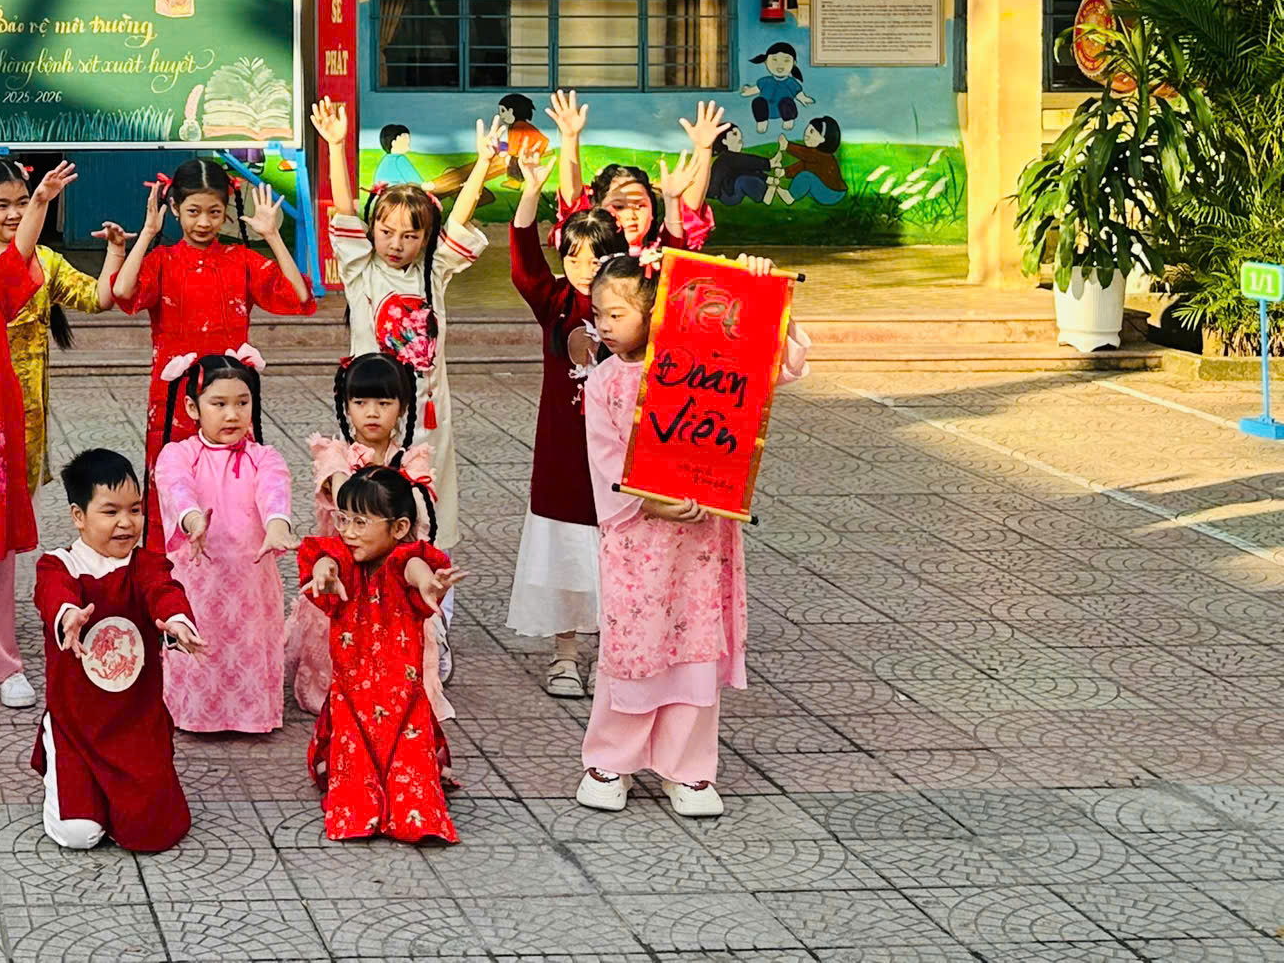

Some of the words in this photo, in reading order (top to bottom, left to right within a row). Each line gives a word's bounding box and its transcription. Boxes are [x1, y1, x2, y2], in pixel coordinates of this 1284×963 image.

[55, 17, 86, 35] môi
[325, 43, 349, 76] PHÁT
[1249, 270, 1276, 294] 1/1
[656, 348, 748, 408] Đoàn
[649, 396, 737, 454] Viên
